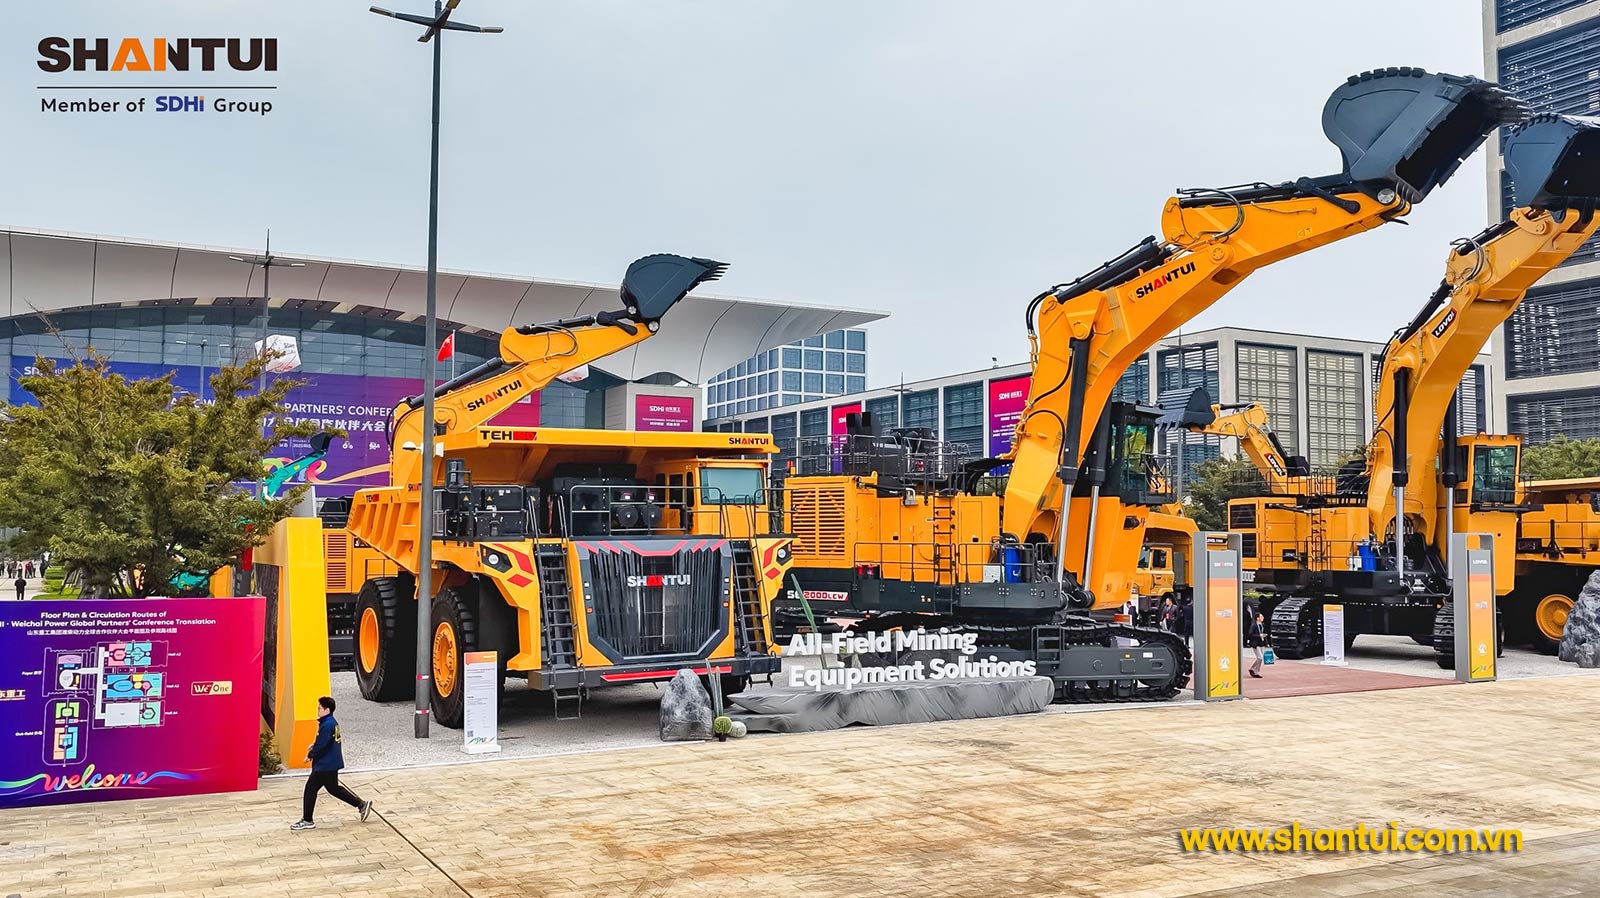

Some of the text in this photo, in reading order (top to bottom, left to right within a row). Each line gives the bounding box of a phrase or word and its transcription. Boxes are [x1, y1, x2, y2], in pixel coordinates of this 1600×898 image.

[1135, 261, 1196, 299] SHANTUI
[467, 379, 522, 412] SHANTUI
[284, 403, 393, 417] PARTNERS' CONFER
[728, 437, 769, 445] SHANTUI
[627, 575, 691, 587] SHANTUI
[70, 619, 95, 627] Global
[787, 627, 978, 656] All-Field Mining
[788, 660, 925, 692] Equipment
[929, 655, 1037, 680] Solutions
[44, 764, 148, 791] welcome
